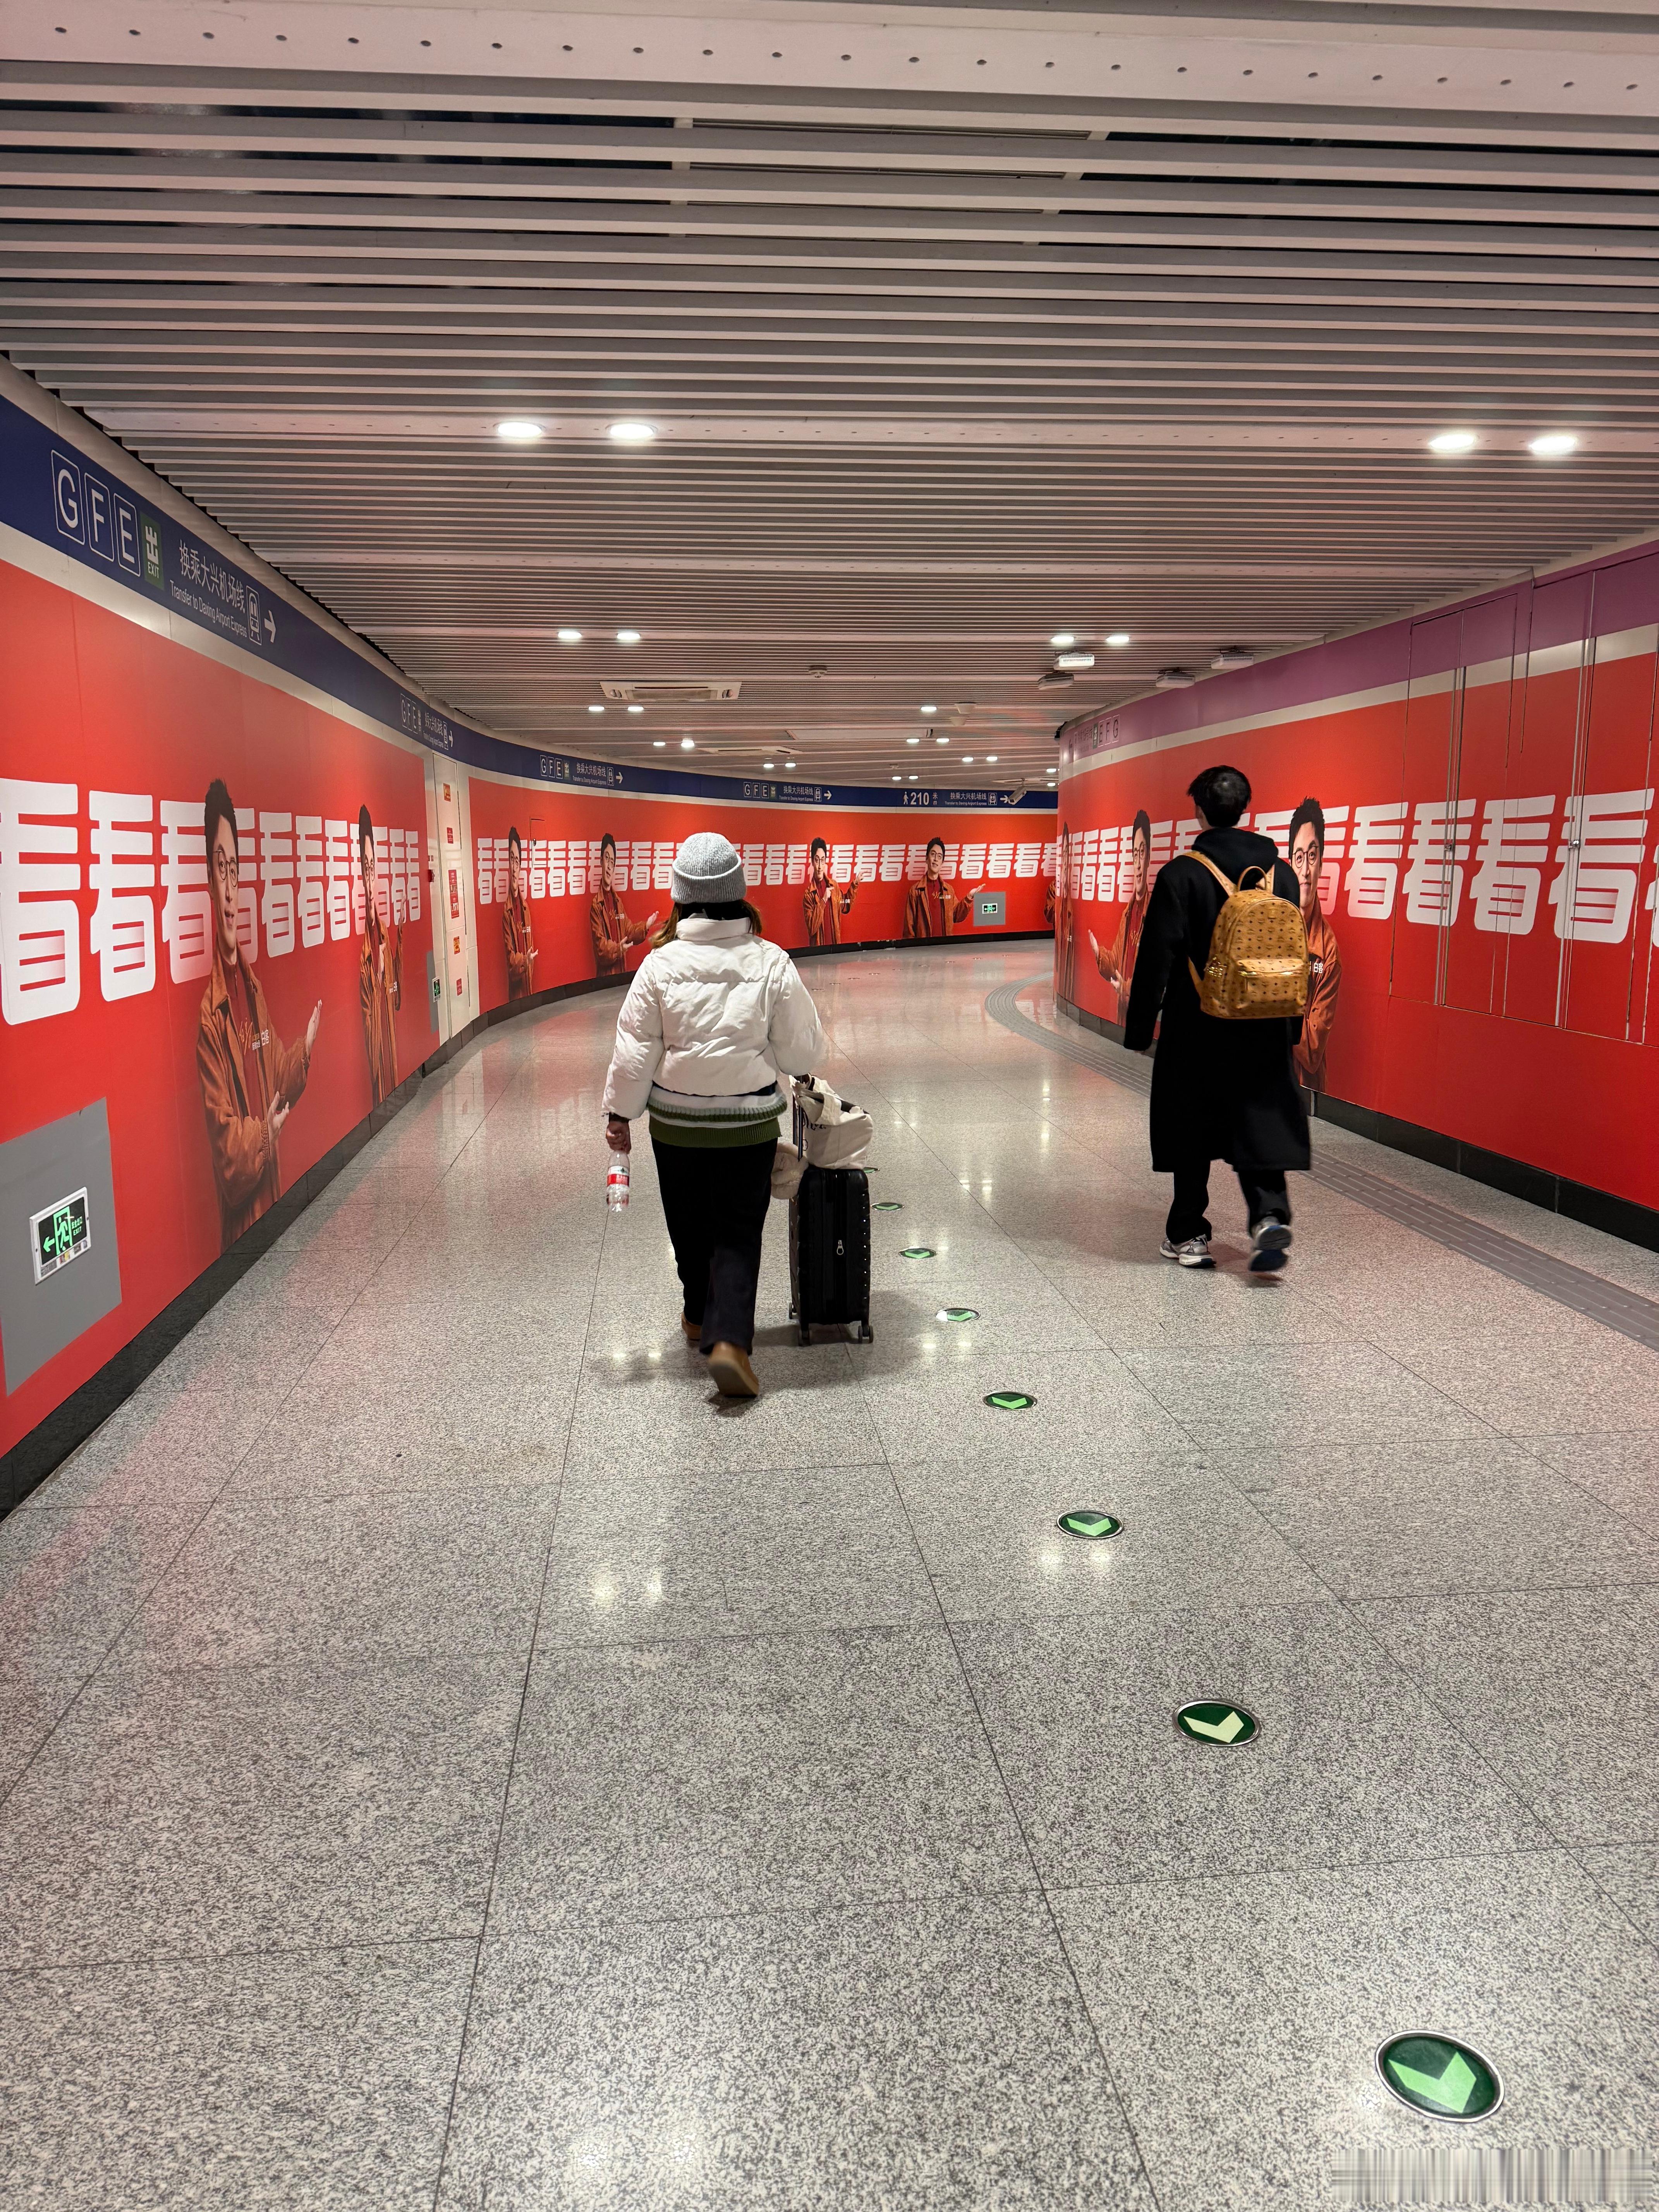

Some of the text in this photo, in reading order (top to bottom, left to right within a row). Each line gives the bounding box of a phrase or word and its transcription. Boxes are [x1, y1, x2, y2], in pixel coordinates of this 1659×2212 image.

[57, 468, 135, 564] G F E
[148, 562, 159, 579] EXIT
[179, 539, 245, 614] 换乘大兴机场线
[170, 580, 247, 637] Transfer to Daxing Airport Express
[401, 699, 406, 723] G
[407, 702, 410, 725] F
[413, 706, 417, 729] E
[1099, 724, 1103, 743] E
[1106, 721, 1111, 740] F
[1113, 719, 1119, 738] G
[541, 758, 562, 776] G F E
[745, 784, 767, 797] G F E
[910, 792, 929, 805] 210
[73, 1226, 82, 1236] EXIT
